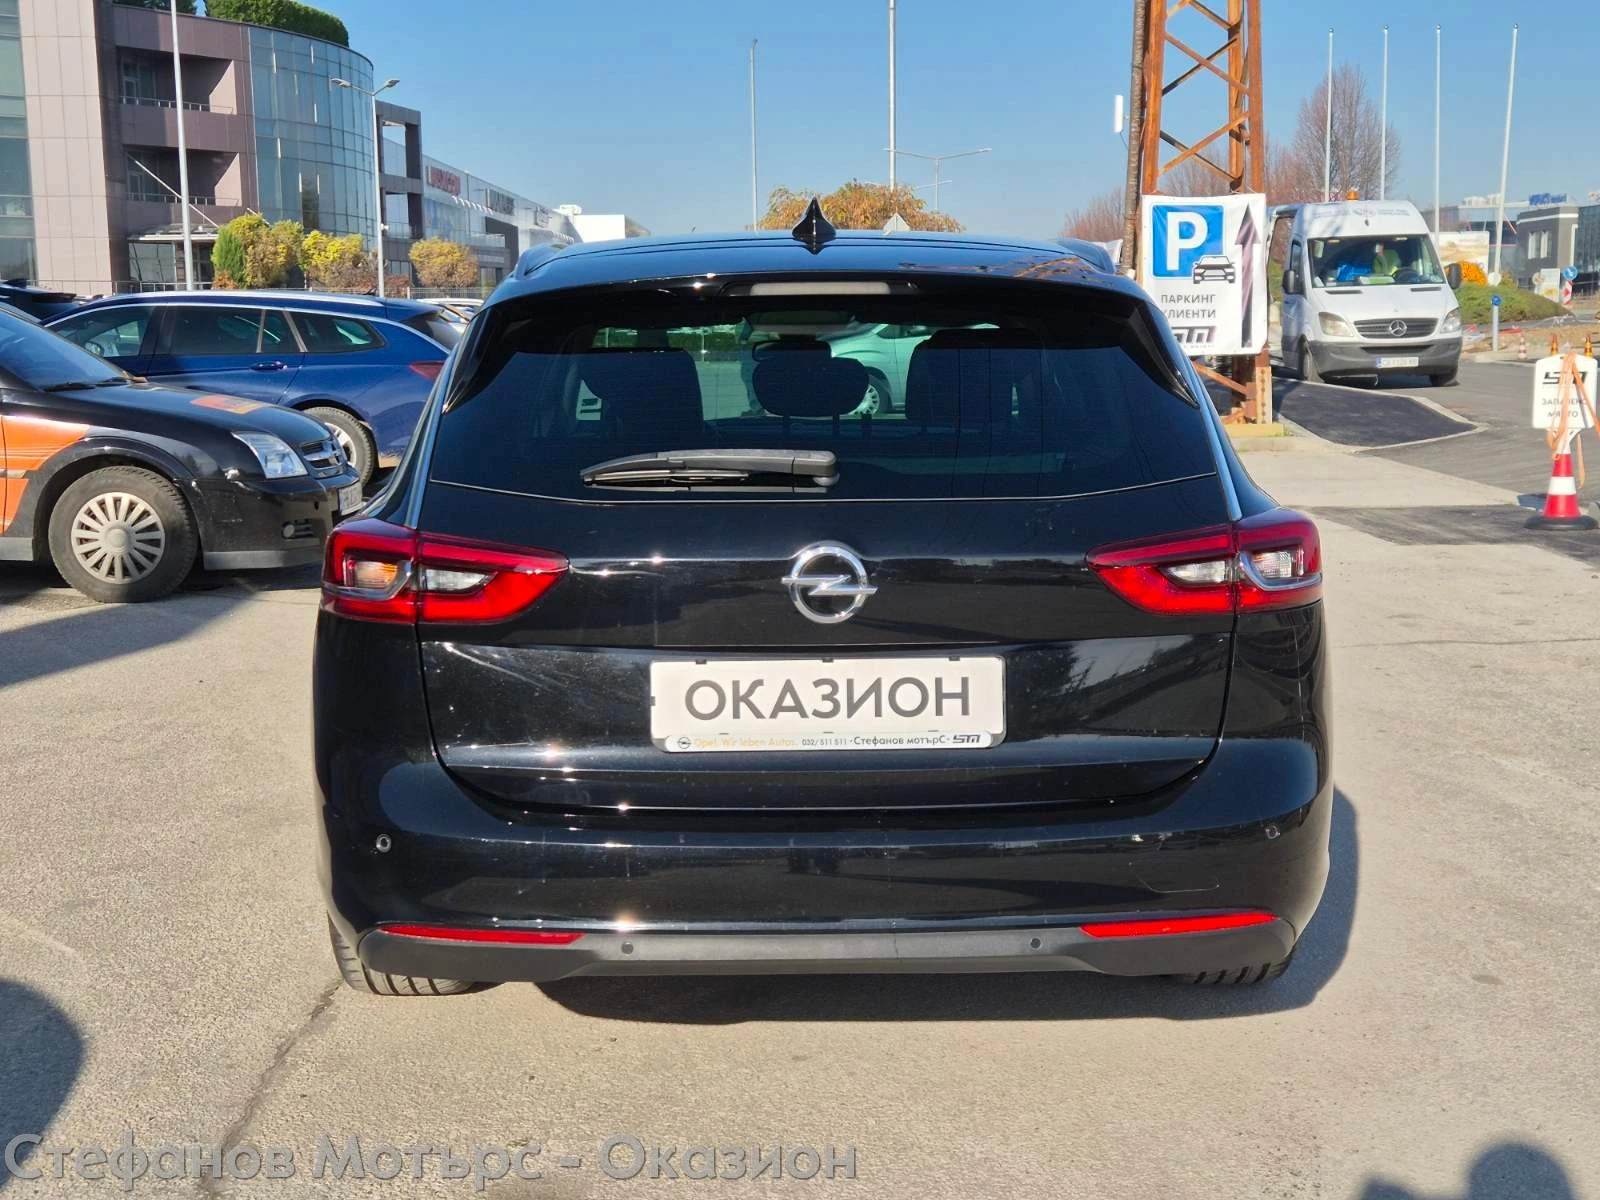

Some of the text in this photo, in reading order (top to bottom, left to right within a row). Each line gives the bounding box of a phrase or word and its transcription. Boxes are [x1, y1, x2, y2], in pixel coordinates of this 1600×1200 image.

[1166, 211, 1208, 271] P
[1161, 294, 1216, 304] ПАРКИНГ
[685, 676, 970, 721] ОКАЗИОН
